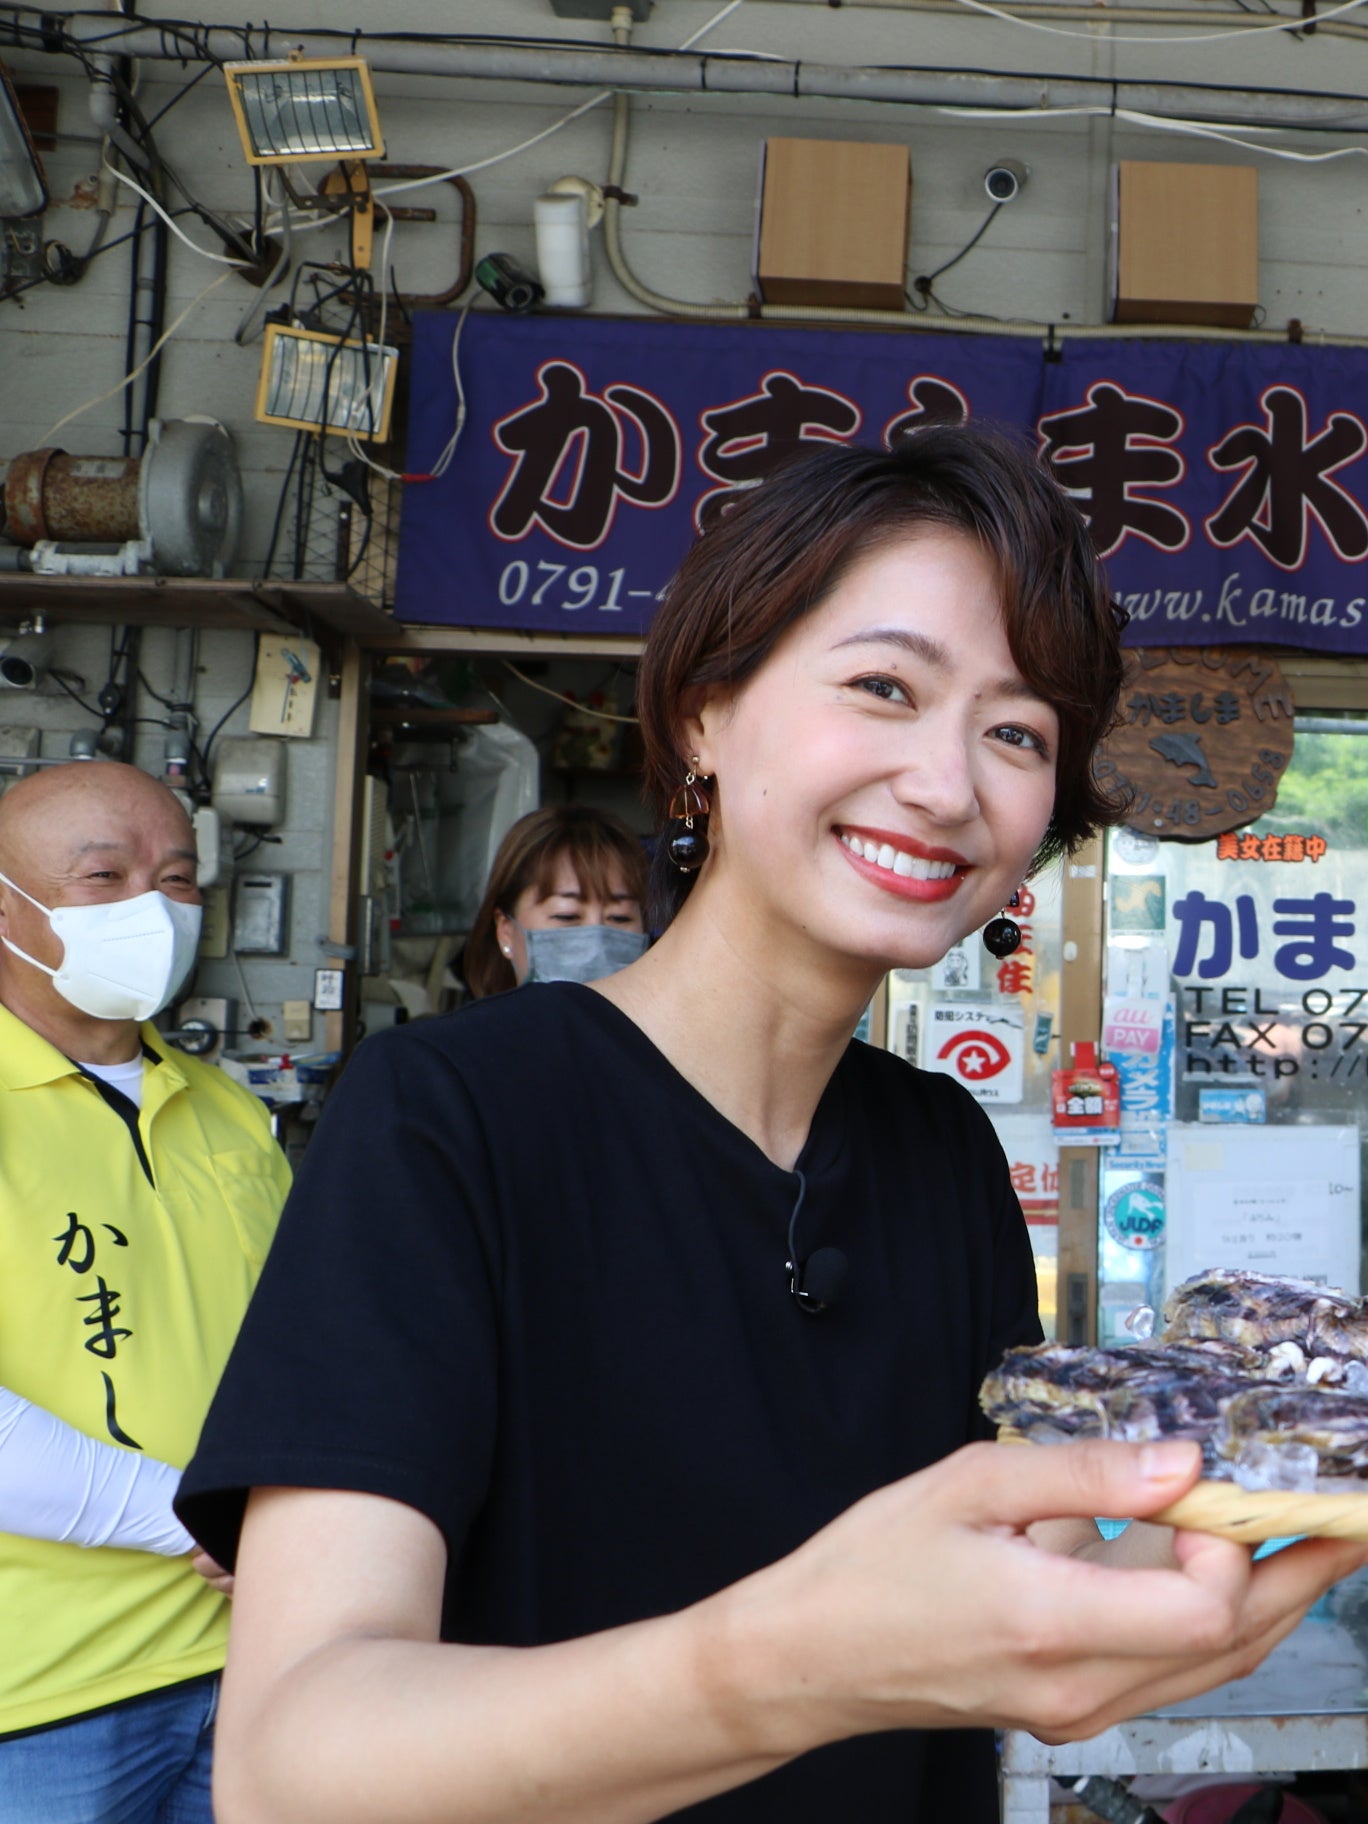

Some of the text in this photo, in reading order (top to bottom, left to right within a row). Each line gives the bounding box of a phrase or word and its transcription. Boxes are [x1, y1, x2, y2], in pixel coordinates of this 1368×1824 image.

[1127, 690, 1240, 726] かましま
[1216, 831, 1327, 862] 美女在籍中
[1184, 987, 1279, 1014] TEL
[1113, 1028, 1150, 1046] PAY
[1185, 1021, 1278, 1049] FAX
[52, 1211, 143, 1451] かまし
